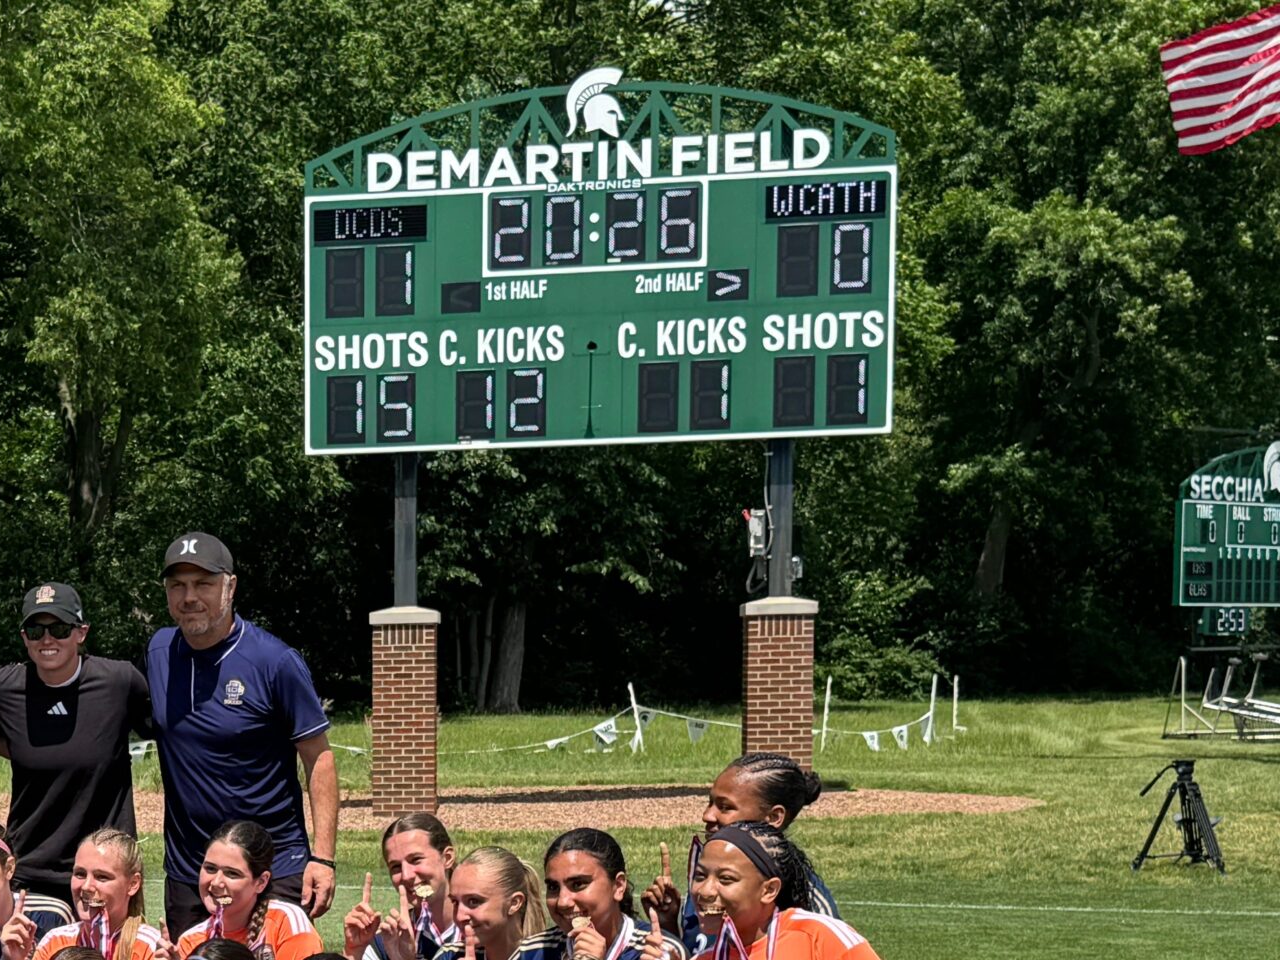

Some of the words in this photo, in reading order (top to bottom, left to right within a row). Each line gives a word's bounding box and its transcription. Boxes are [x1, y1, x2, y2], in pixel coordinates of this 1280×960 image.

[367, 138, 652, 192] DEMARTIN
[672, 128, 831, 177] FIELD
[547, 178, 642, 193] DAKTRONICS
[773, 181, 876, 216] WCATH
[494, 190, 696, 263] 20:26
[833, 223, 870, 289] 0
[484, 281, 507, 301] 1st
[510, 279, 548, 300] HALF
[635, 274, 662, 294] 2nd
[665, 271, 704, 292] HALF
[439, 329, 467, 366] C.
[477, 324, 565, 364] KICKS
[617, 321, 646, 358] C.
[656, 315, 747, 356] KICKS
[762, 309, 885, 352] SHOTS
[314, 331, 429, 371] SHOTS
[356, 375, 413, 437] 15
[486, 369, 544, 432] 12
[1190, 474, 1265, 503] SECCHIA
[1196, 504, 1214, 519] TIME
[1232, 505, 1251, 521] BALL
[1217, 608, 1245, 632] 2:53
